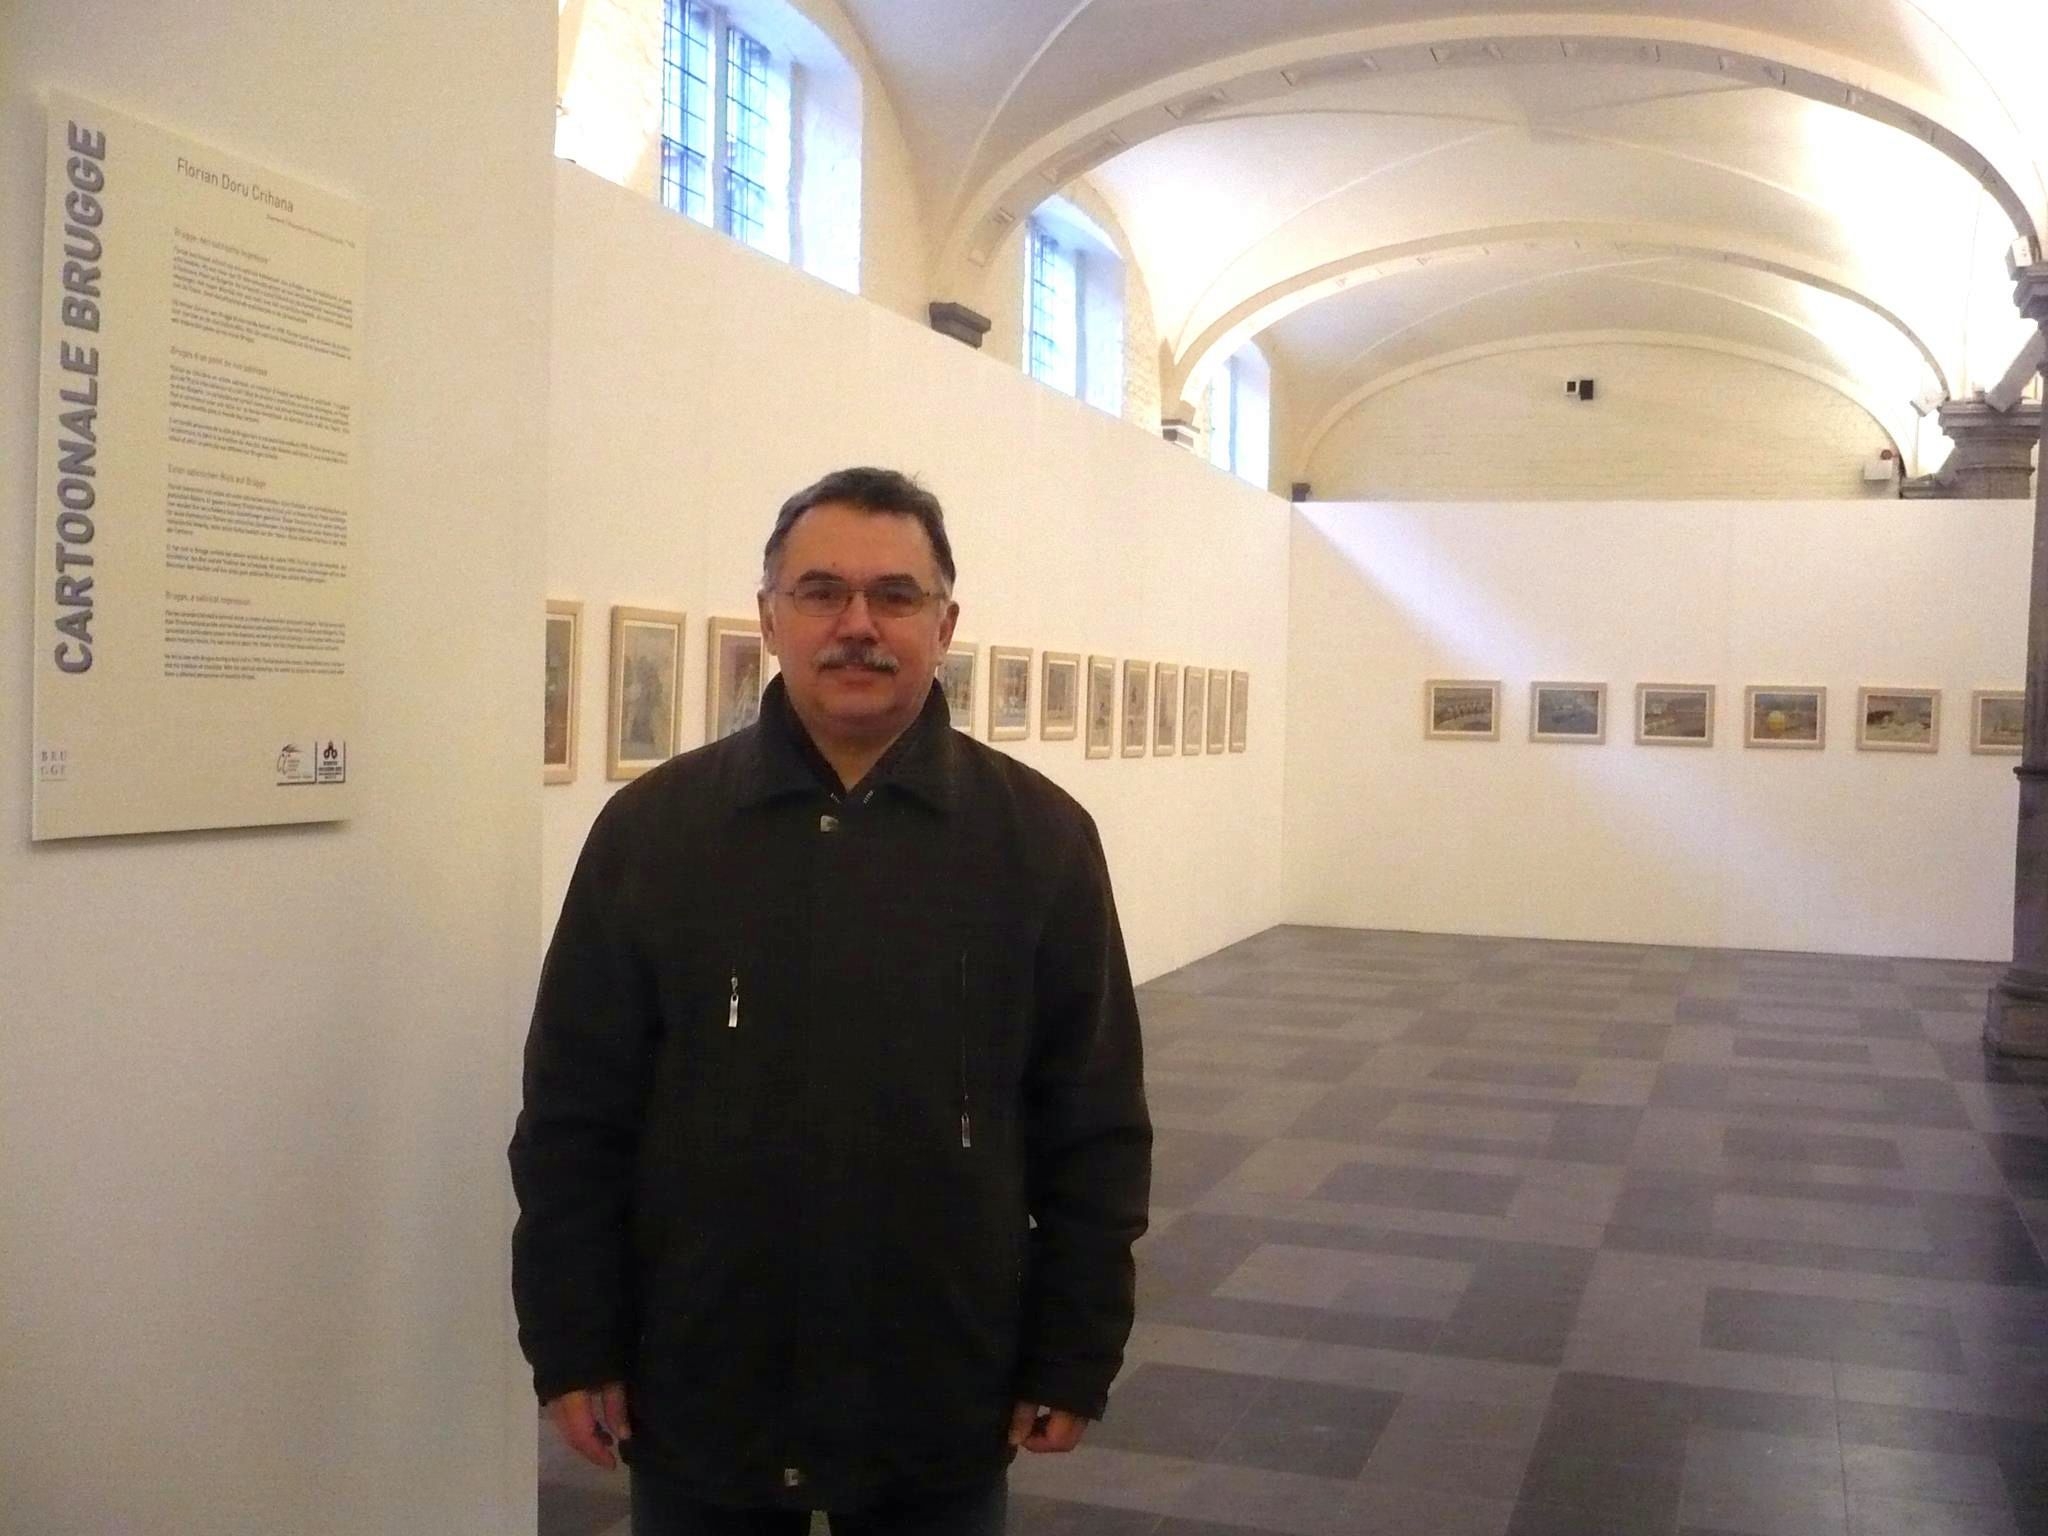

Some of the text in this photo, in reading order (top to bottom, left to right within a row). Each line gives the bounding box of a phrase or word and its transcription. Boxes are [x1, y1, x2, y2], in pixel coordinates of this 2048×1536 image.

[177, 157, 294, 213] Florian Doru Crihana
[54, 120, 106, 674] CARTOONALE BRUGGE
